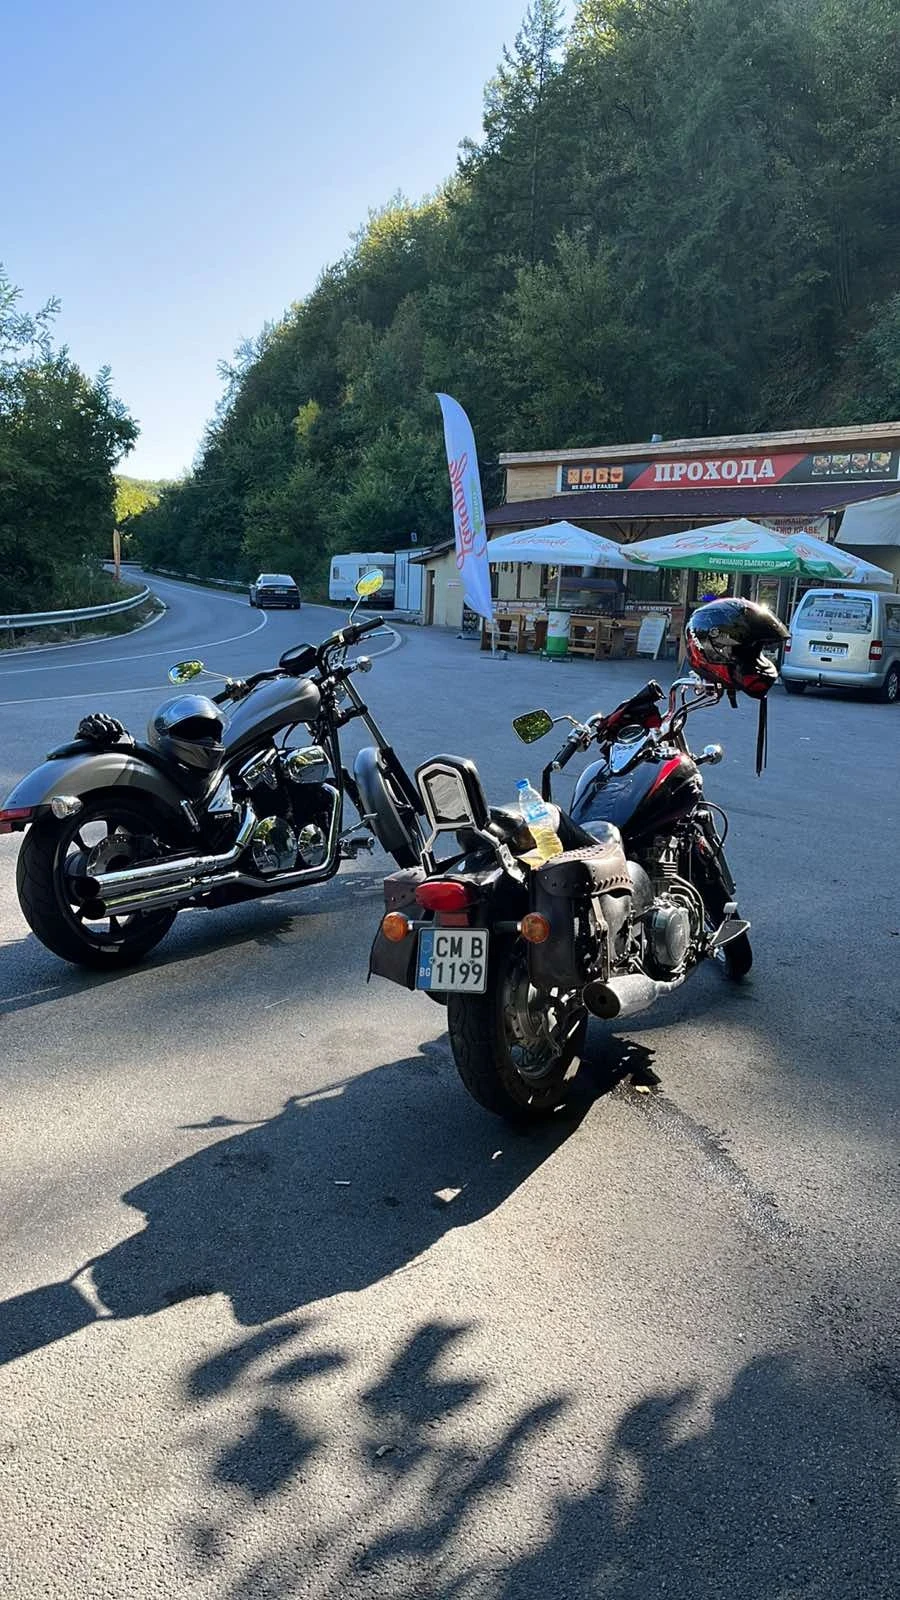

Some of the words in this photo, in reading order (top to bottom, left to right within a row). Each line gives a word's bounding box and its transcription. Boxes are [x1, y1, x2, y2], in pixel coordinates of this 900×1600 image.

[653, 458, 776, 484] ПРОХОДА
[436, 936, 463, 958] CM
[471, 936, 483, 959] B
[419, 967, 431, 977] BG
[436, 961, 483, 985] 1199
